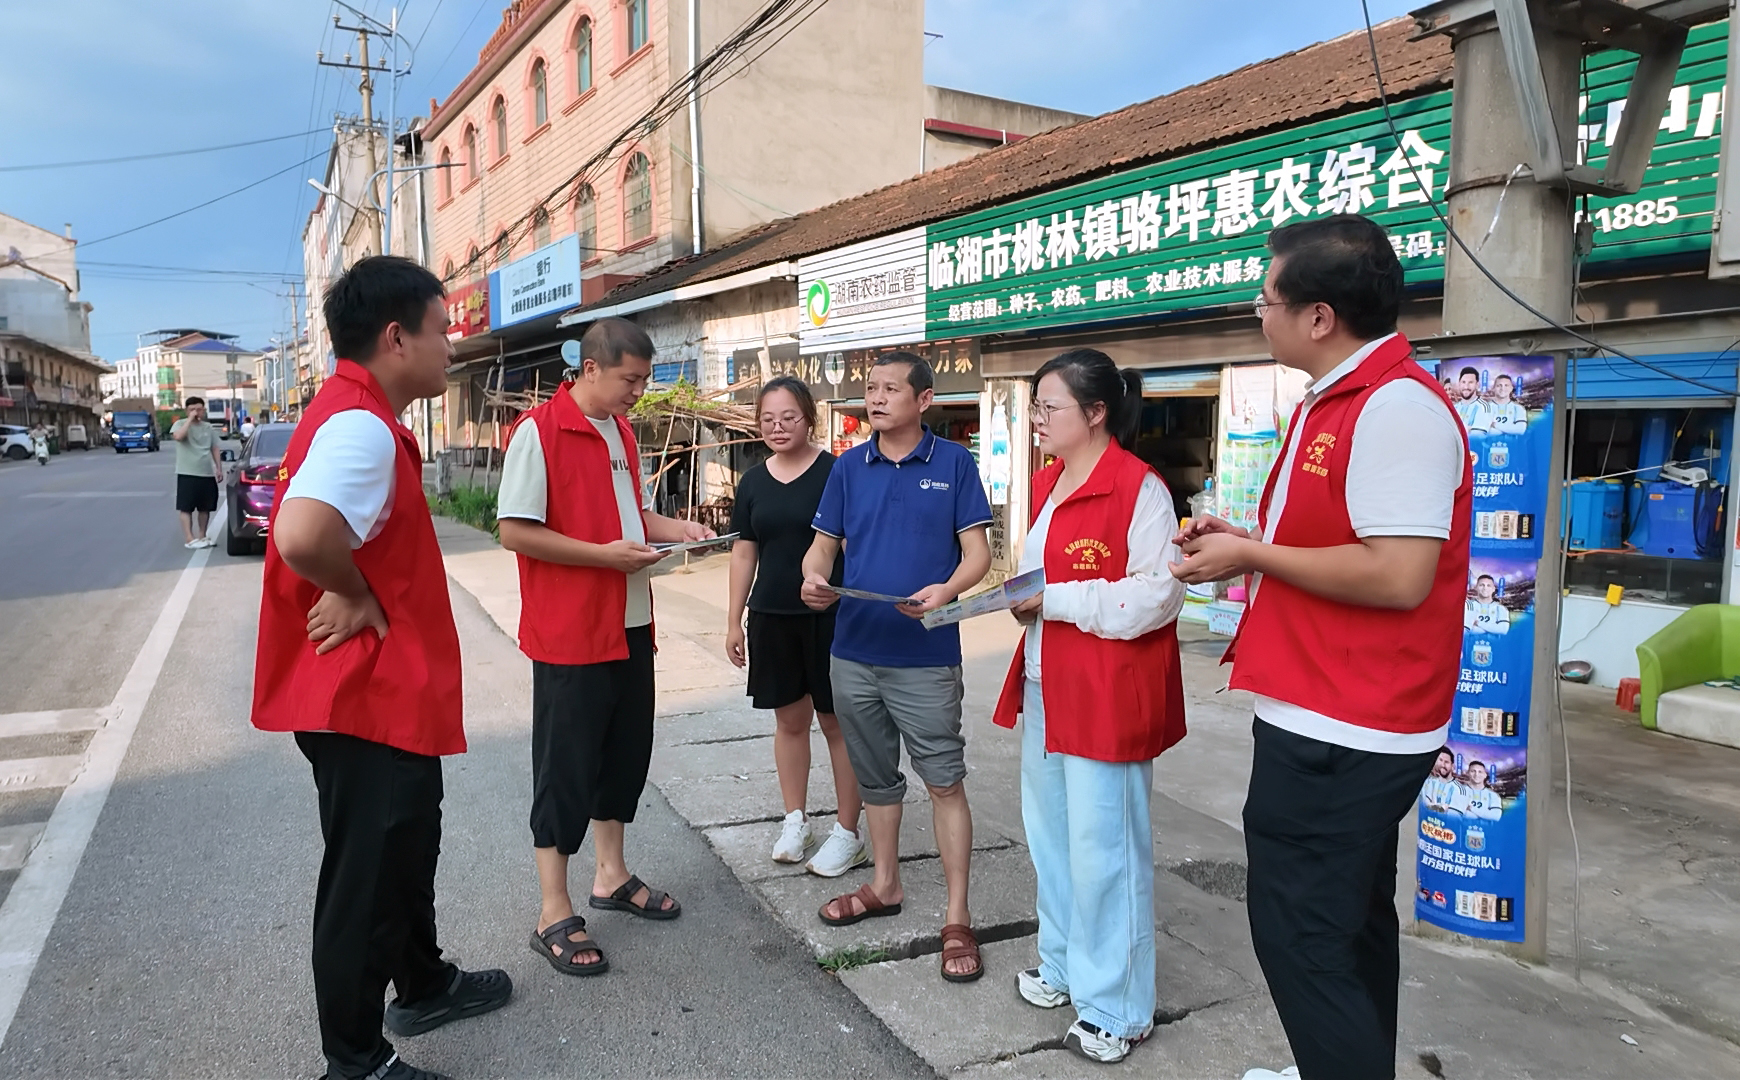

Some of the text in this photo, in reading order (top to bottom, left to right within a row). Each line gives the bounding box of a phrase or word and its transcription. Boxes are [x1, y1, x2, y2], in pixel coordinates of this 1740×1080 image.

[1574, 196, 1679, 234] 1885
[835, 266, 916, 305] 湖南农药监管
